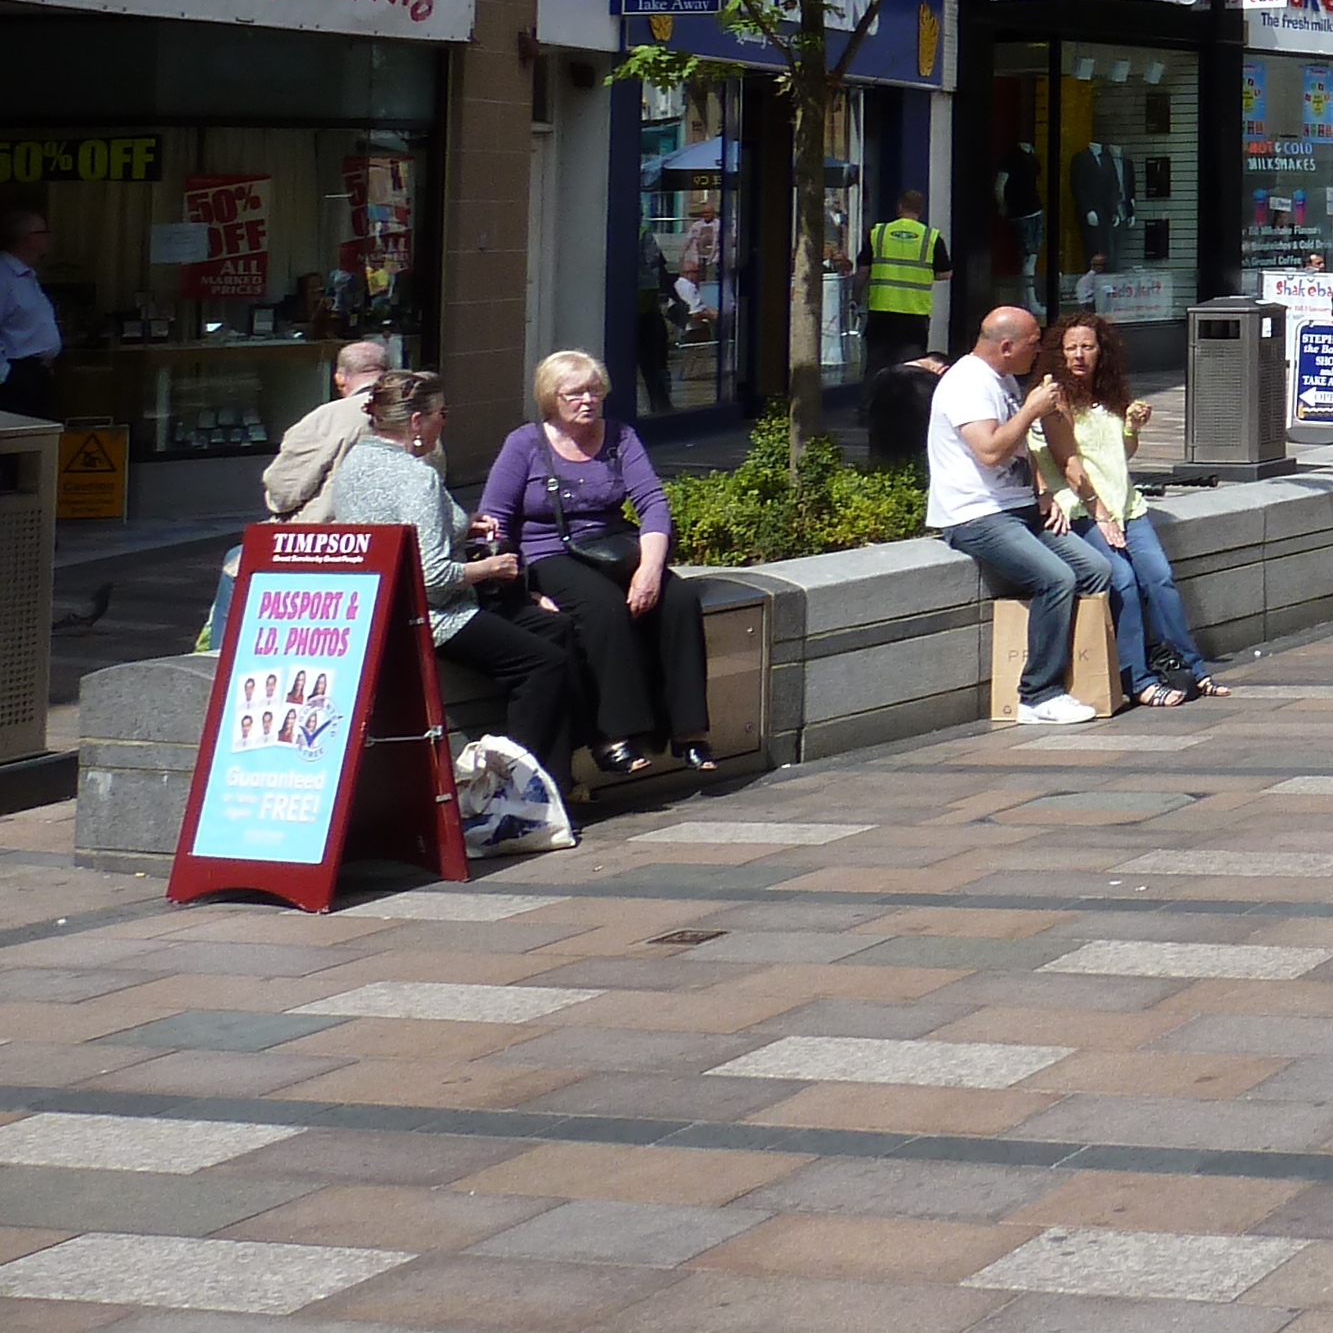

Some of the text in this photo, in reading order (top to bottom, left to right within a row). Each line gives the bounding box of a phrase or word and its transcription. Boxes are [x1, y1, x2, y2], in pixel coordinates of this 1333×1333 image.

[1260, 12, 1280, 28] The
[1282, 16, 1310, 30] fresh
[77, 137, 157, 181] OFF
[1283, 142, 1314, 155] COLD
[1247, 157, 1317, 171] MILKSHAKES
[186, 183, 263, 225] 50%
[219, 259, 263, 275] ALL
[1303, 344, 1320, 354] the
[1302, 375, 1327, 387] TAKE
[273, 533, 372, 554] TIMPSON
[257, 590, 359, 620] PASSPORT &
[283, 627, 351, 657] PHOTOS
[226, 767, 327, 790] Guaranteed
[259, 792, 321, 823] FREE!
